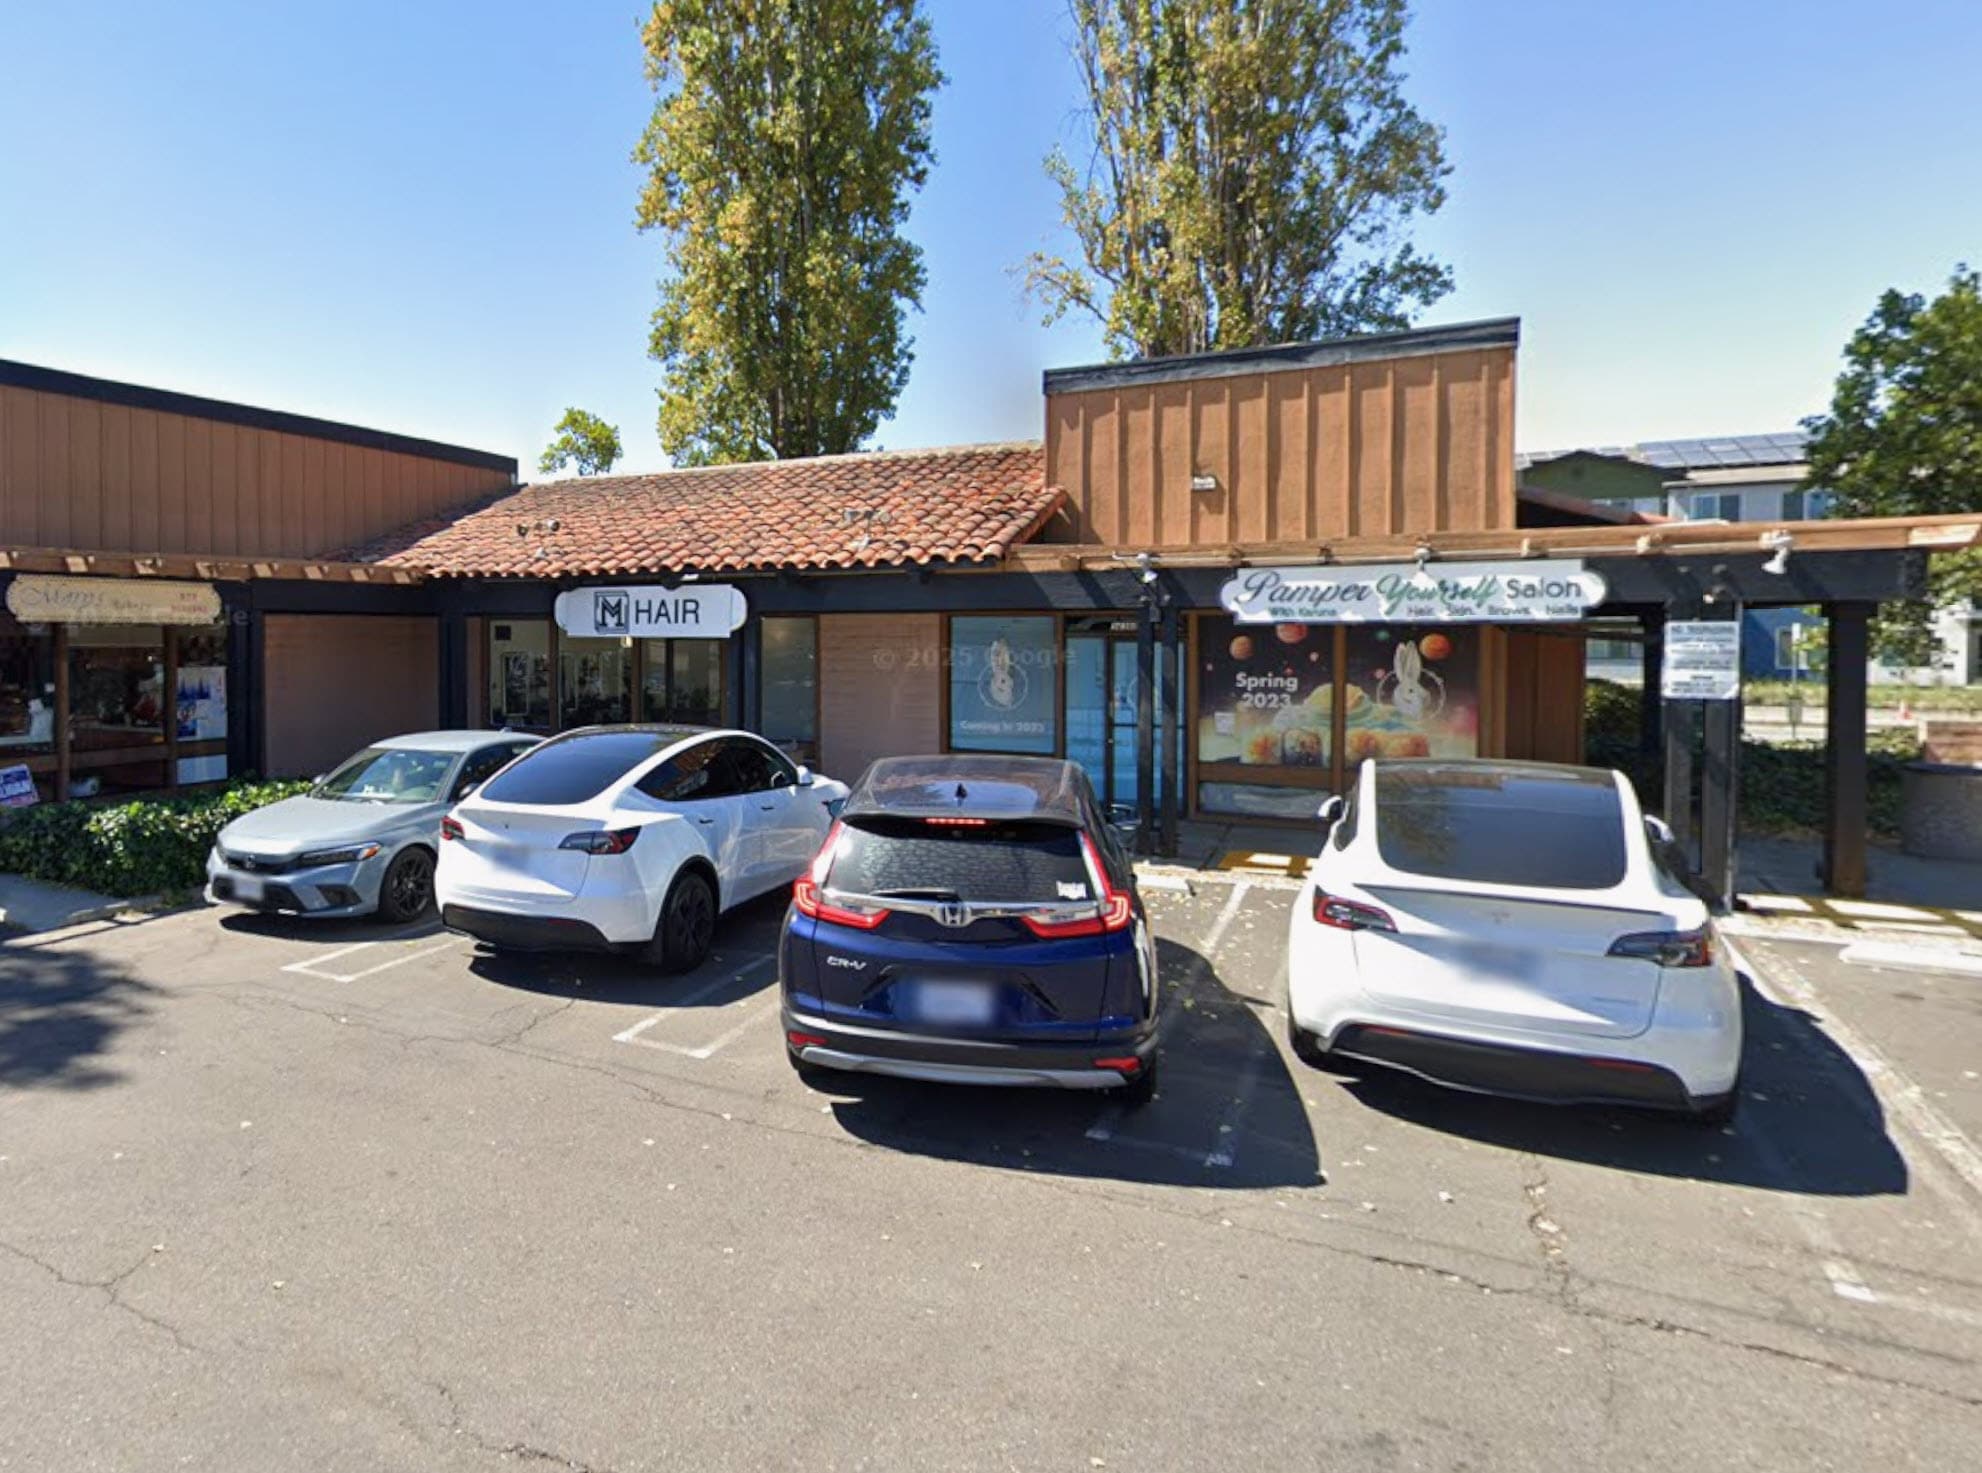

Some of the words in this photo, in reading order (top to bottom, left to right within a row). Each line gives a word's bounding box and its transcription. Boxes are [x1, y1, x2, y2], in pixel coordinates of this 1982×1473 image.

[1234, 571, 1373, 608] Pamper
[1376, 573, 1497, 616] Yourself
[1506, 577, 1582, 600] Salon
[634, 599, 700, 625] HAIR
[1235, 671, 1298, 692] Spring
[1241, 692, 1291, 709] 2023
[826, 955, 867, 970] CR-V
